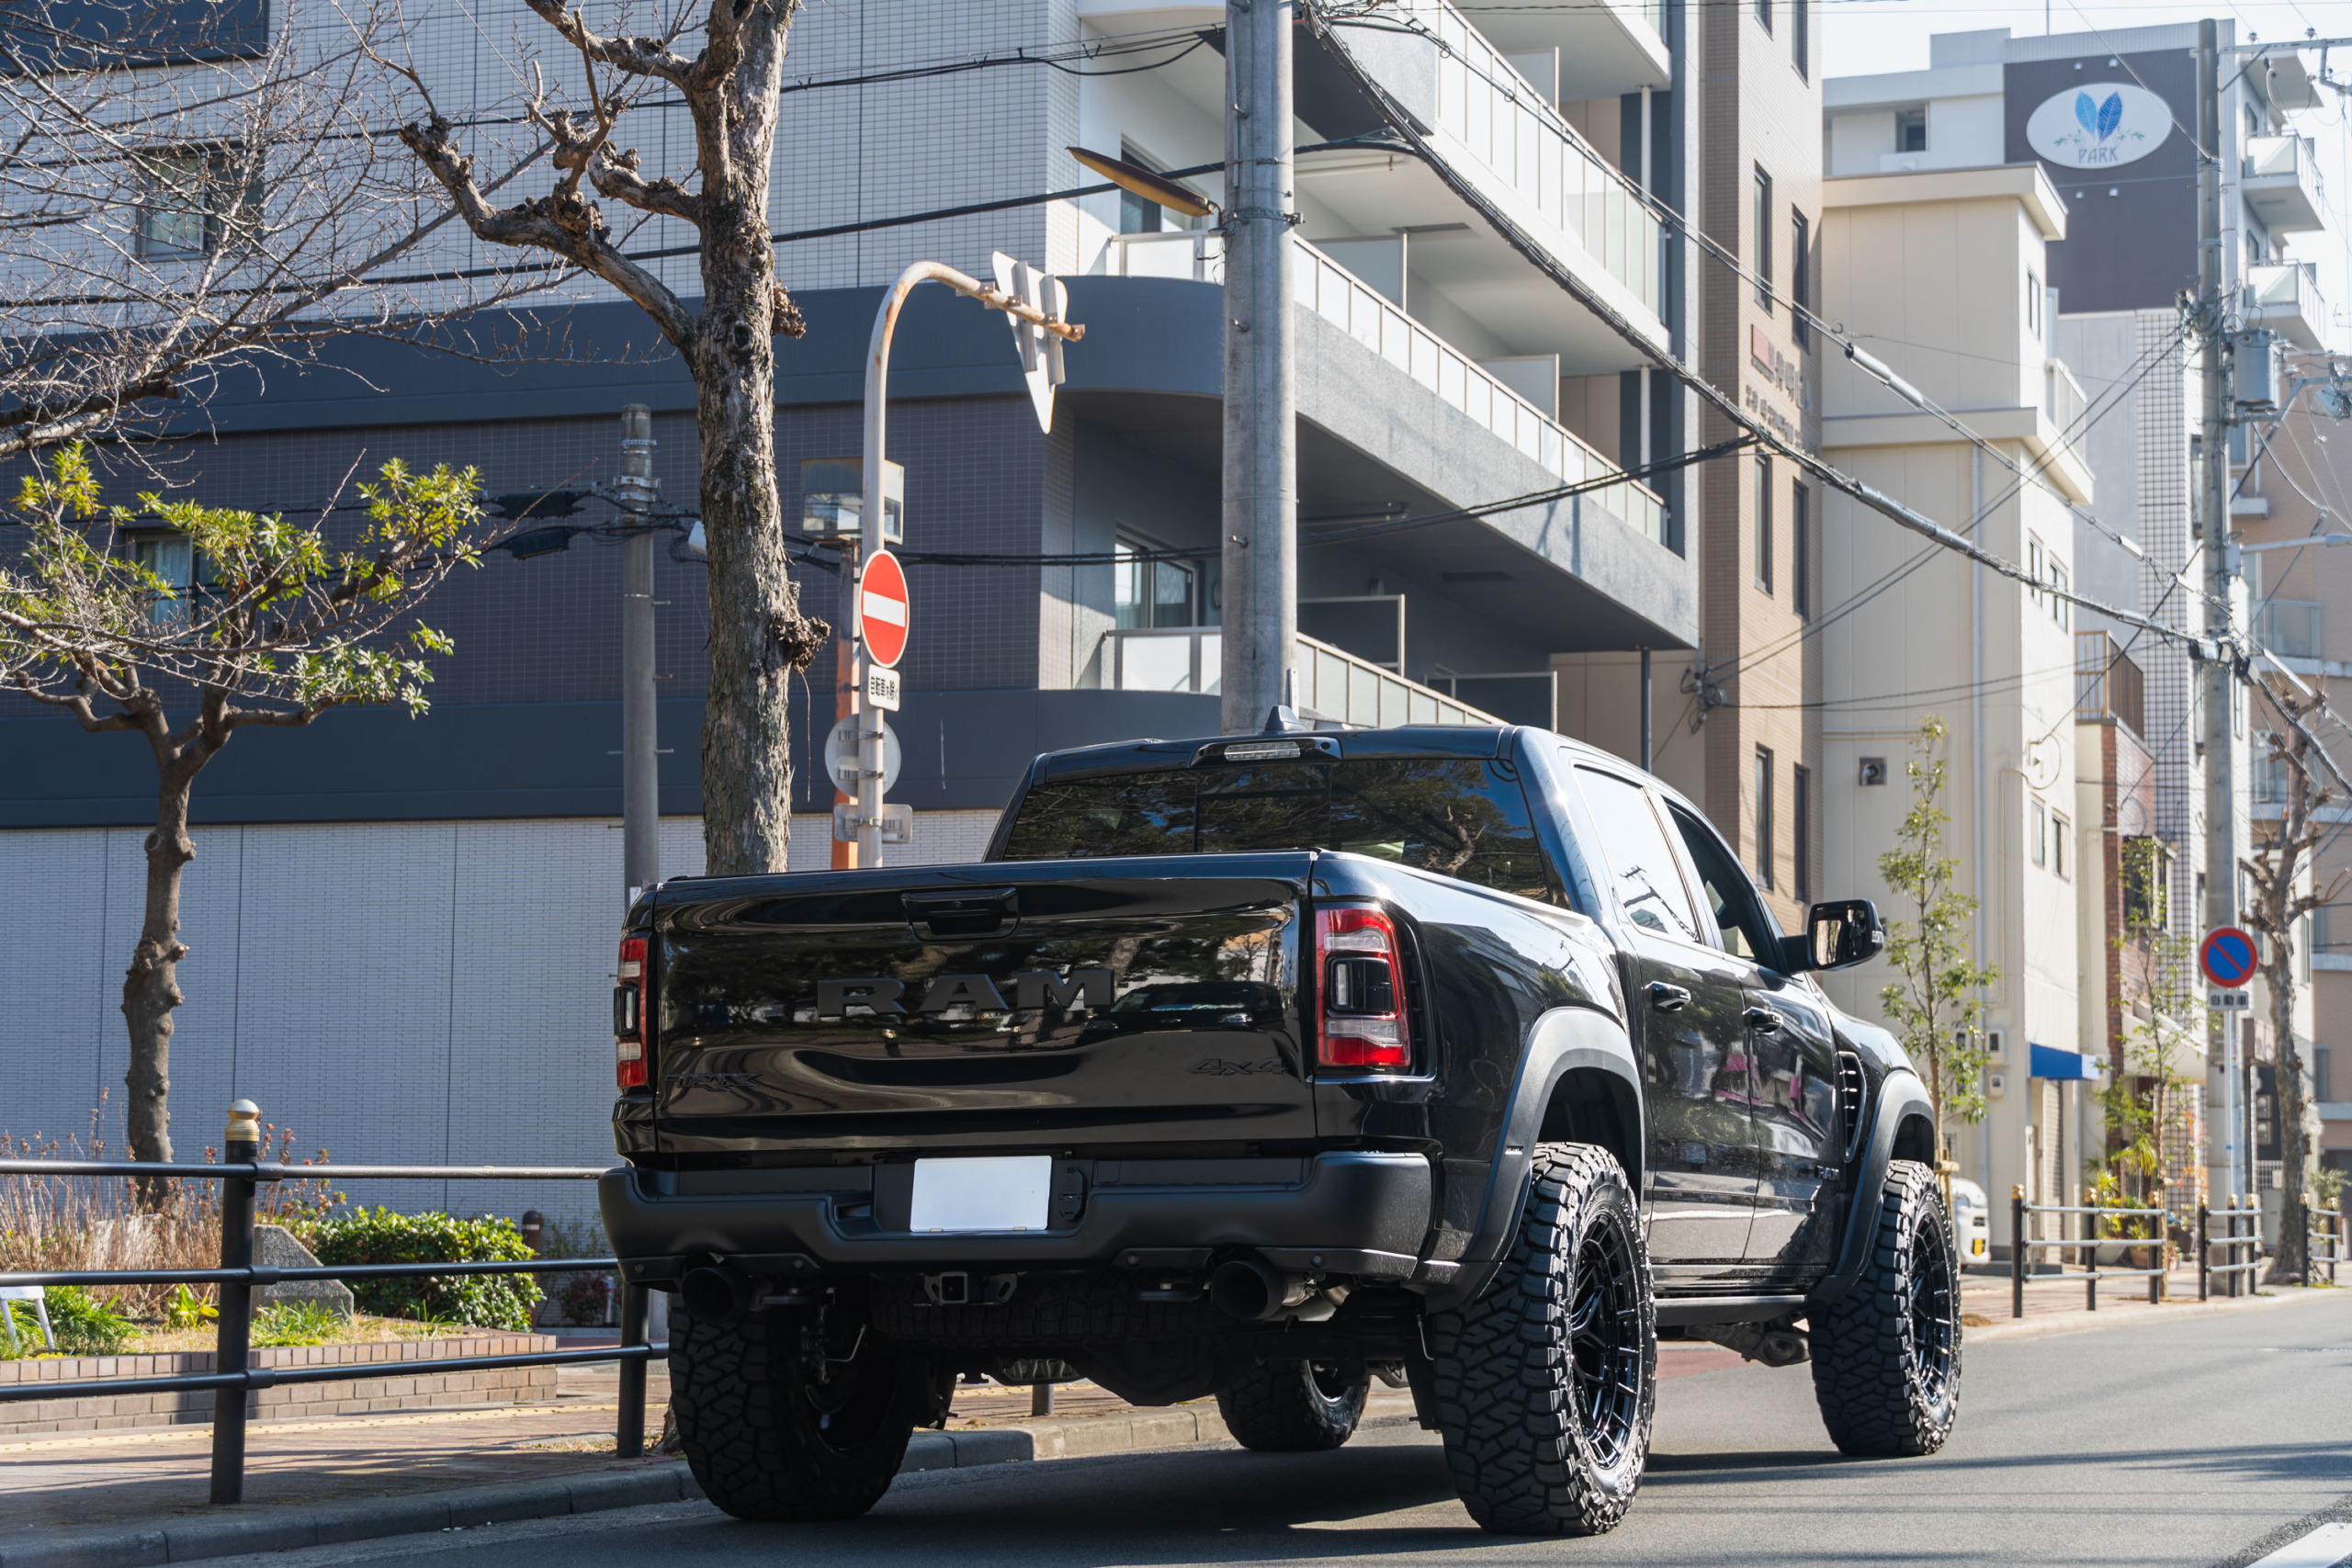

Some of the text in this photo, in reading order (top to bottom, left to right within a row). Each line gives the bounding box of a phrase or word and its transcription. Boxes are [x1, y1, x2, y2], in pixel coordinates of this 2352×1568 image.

[2078, 147, 2120, 164] PARK
[870, 676, 899, 702] 自転車を除く
[818, 968, 1115, 1018] RAM
[2210, 994, 2247, 1006] 自動車
[664, 1072, 767, 1092] TRX
